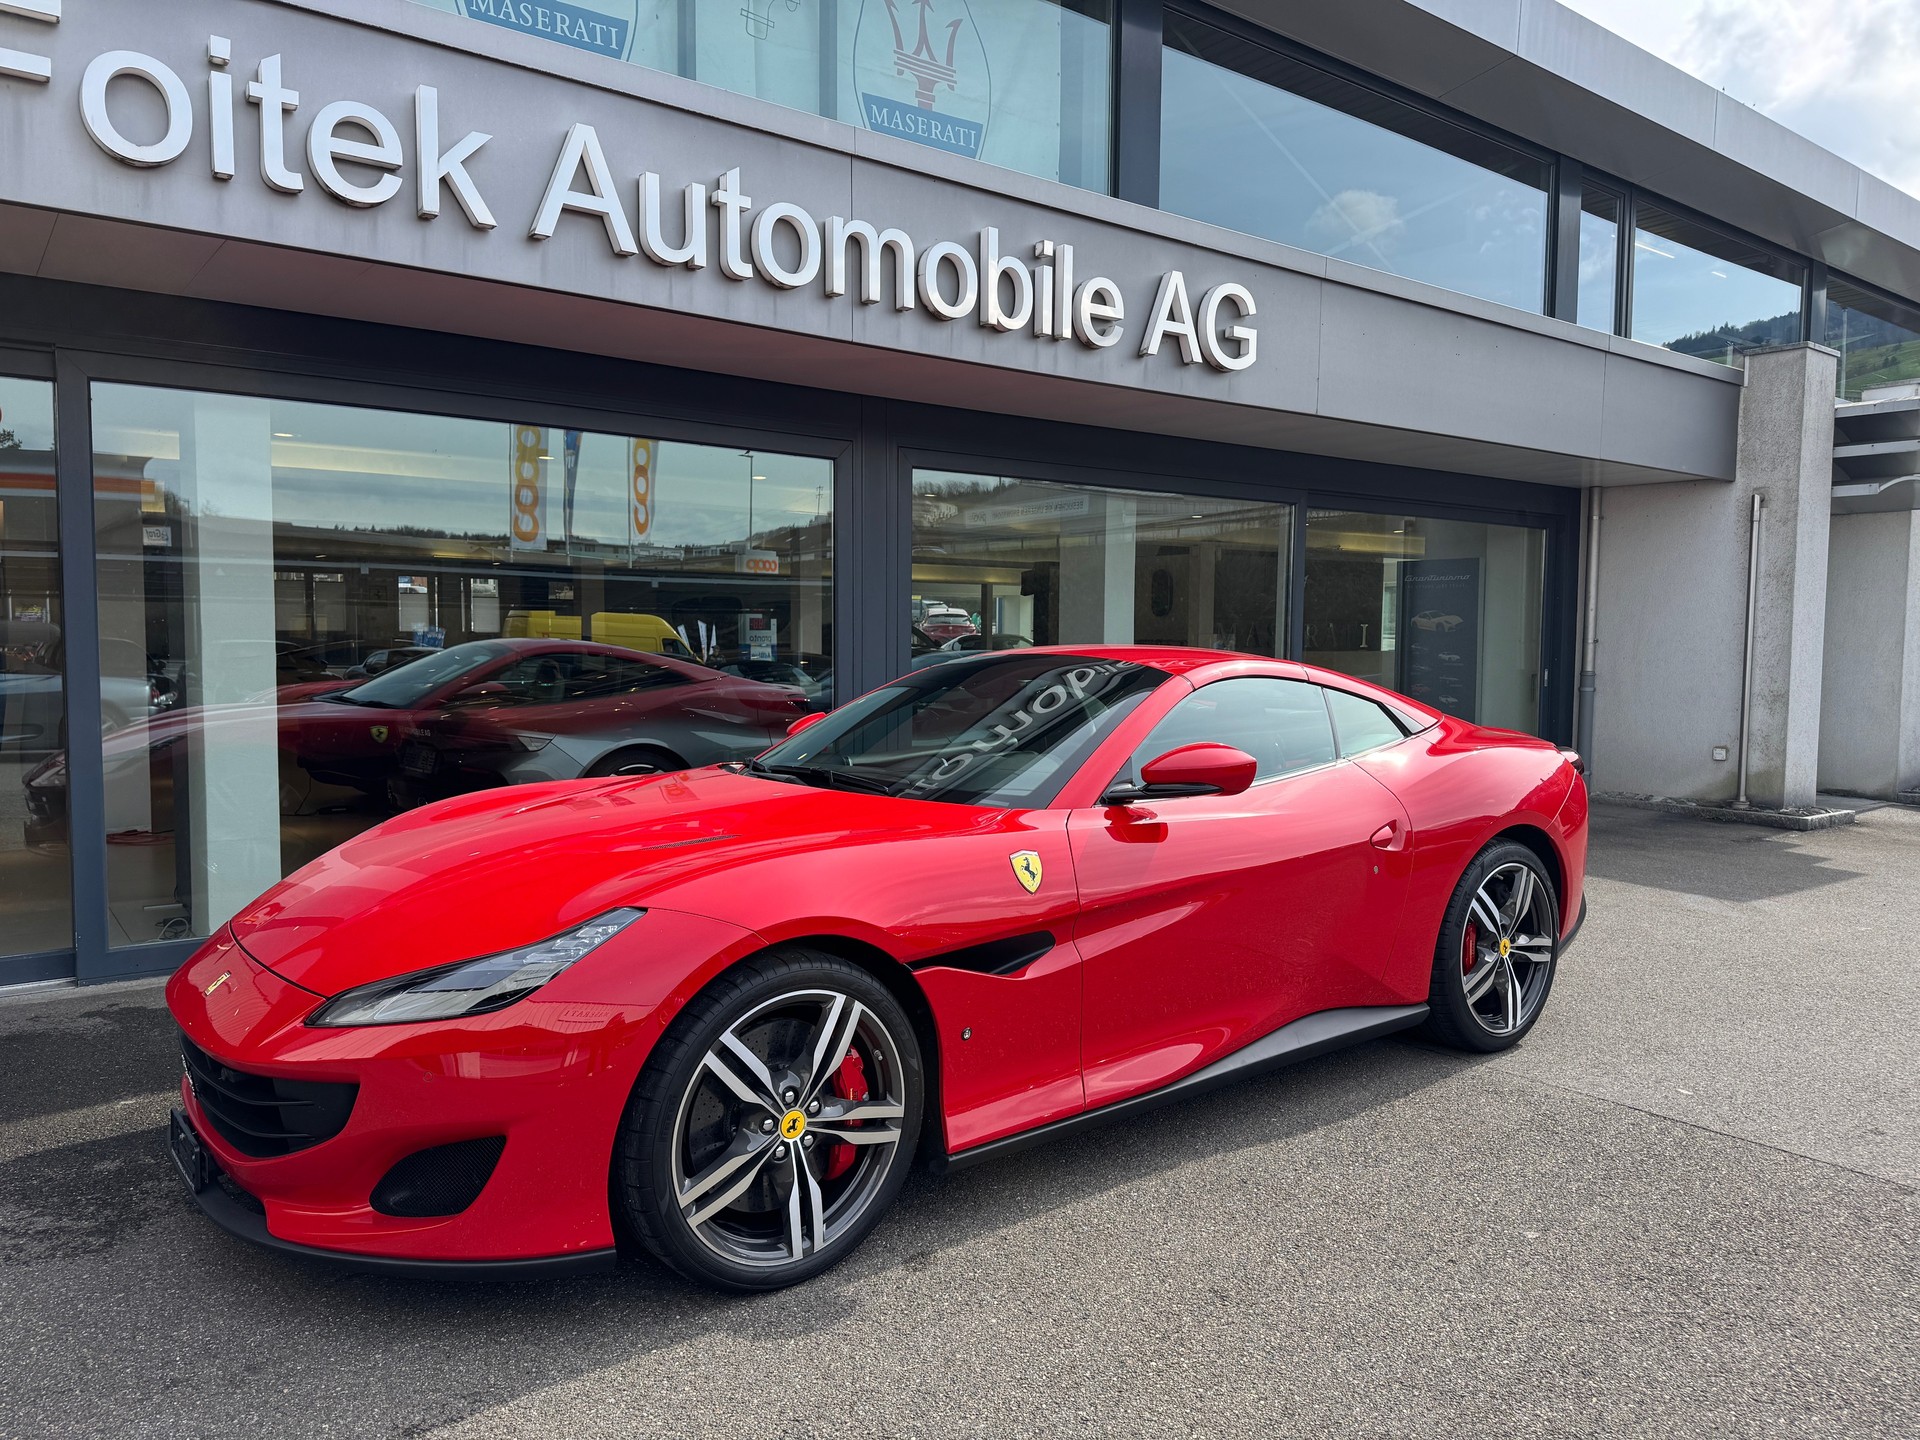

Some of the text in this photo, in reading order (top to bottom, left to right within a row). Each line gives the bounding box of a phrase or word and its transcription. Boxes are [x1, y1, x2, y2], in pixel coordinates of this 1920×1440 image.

[470, 0, 619, 50] MASERATI
[870, 104, 976, 149] MASERATI
[527, 122, 1125, 350] Automobile
[1138, 269, 1258, 372] AG
